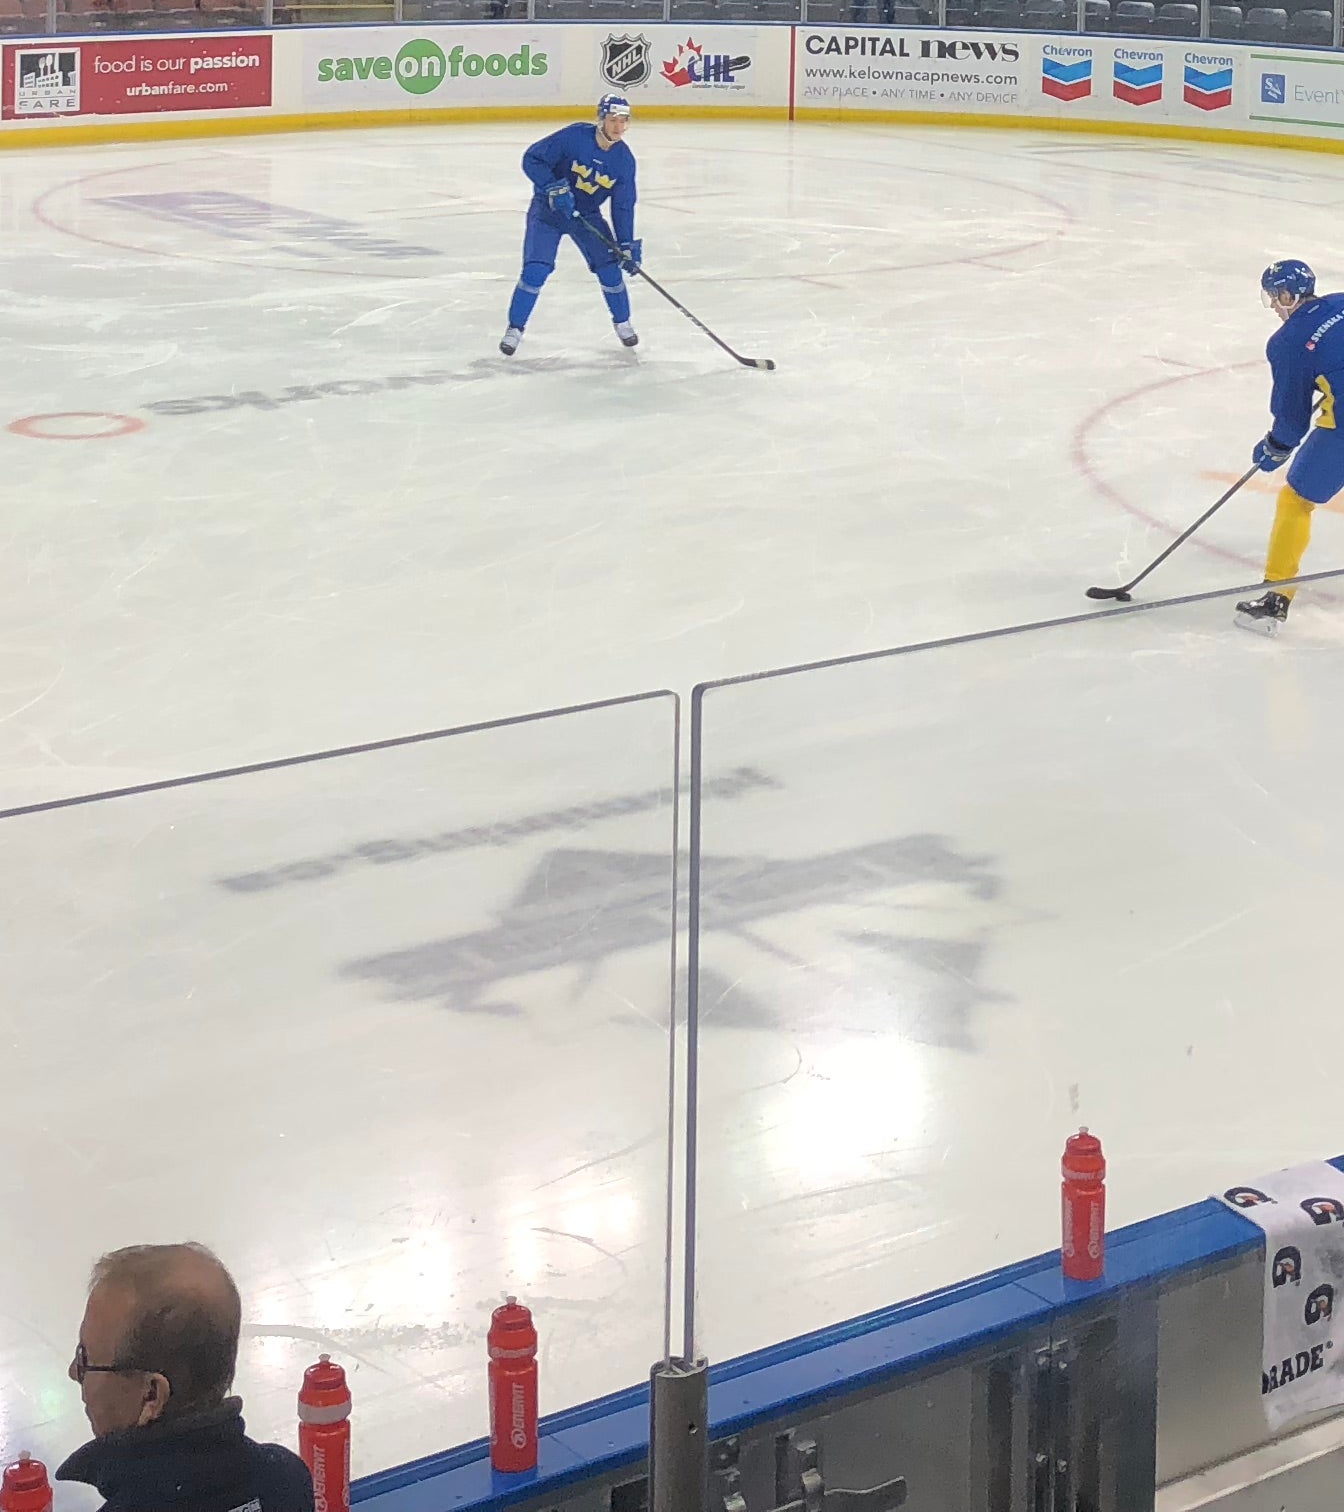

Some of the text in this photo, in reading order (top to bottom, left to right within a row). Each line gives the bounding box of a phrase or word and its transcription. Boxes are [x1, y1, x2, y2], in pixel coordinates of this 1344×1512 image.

[805, 35, 1019, 62] CAPITAL news
[1042, 44, 1093, 58] Chevron
[1114, 48, 1164, 62] Chevron
[94, 52, 260, 74] food is our passion
[613, 46, 643, 75] NHL
[687, 54, 735, 82] CHL
[1184, 52, 1233, 67] Chevron
[805, 64, 1018, 87] www.kelownacapnews.com
[126, 79, 229, 99] urbanfare.com
[805, 86, 1017, 104] ANY PLACE ANY TIME ANY DEVICE
[19, 97, 76, 111] FARE
[1311, 313, 1344, 343] SVENSKA
